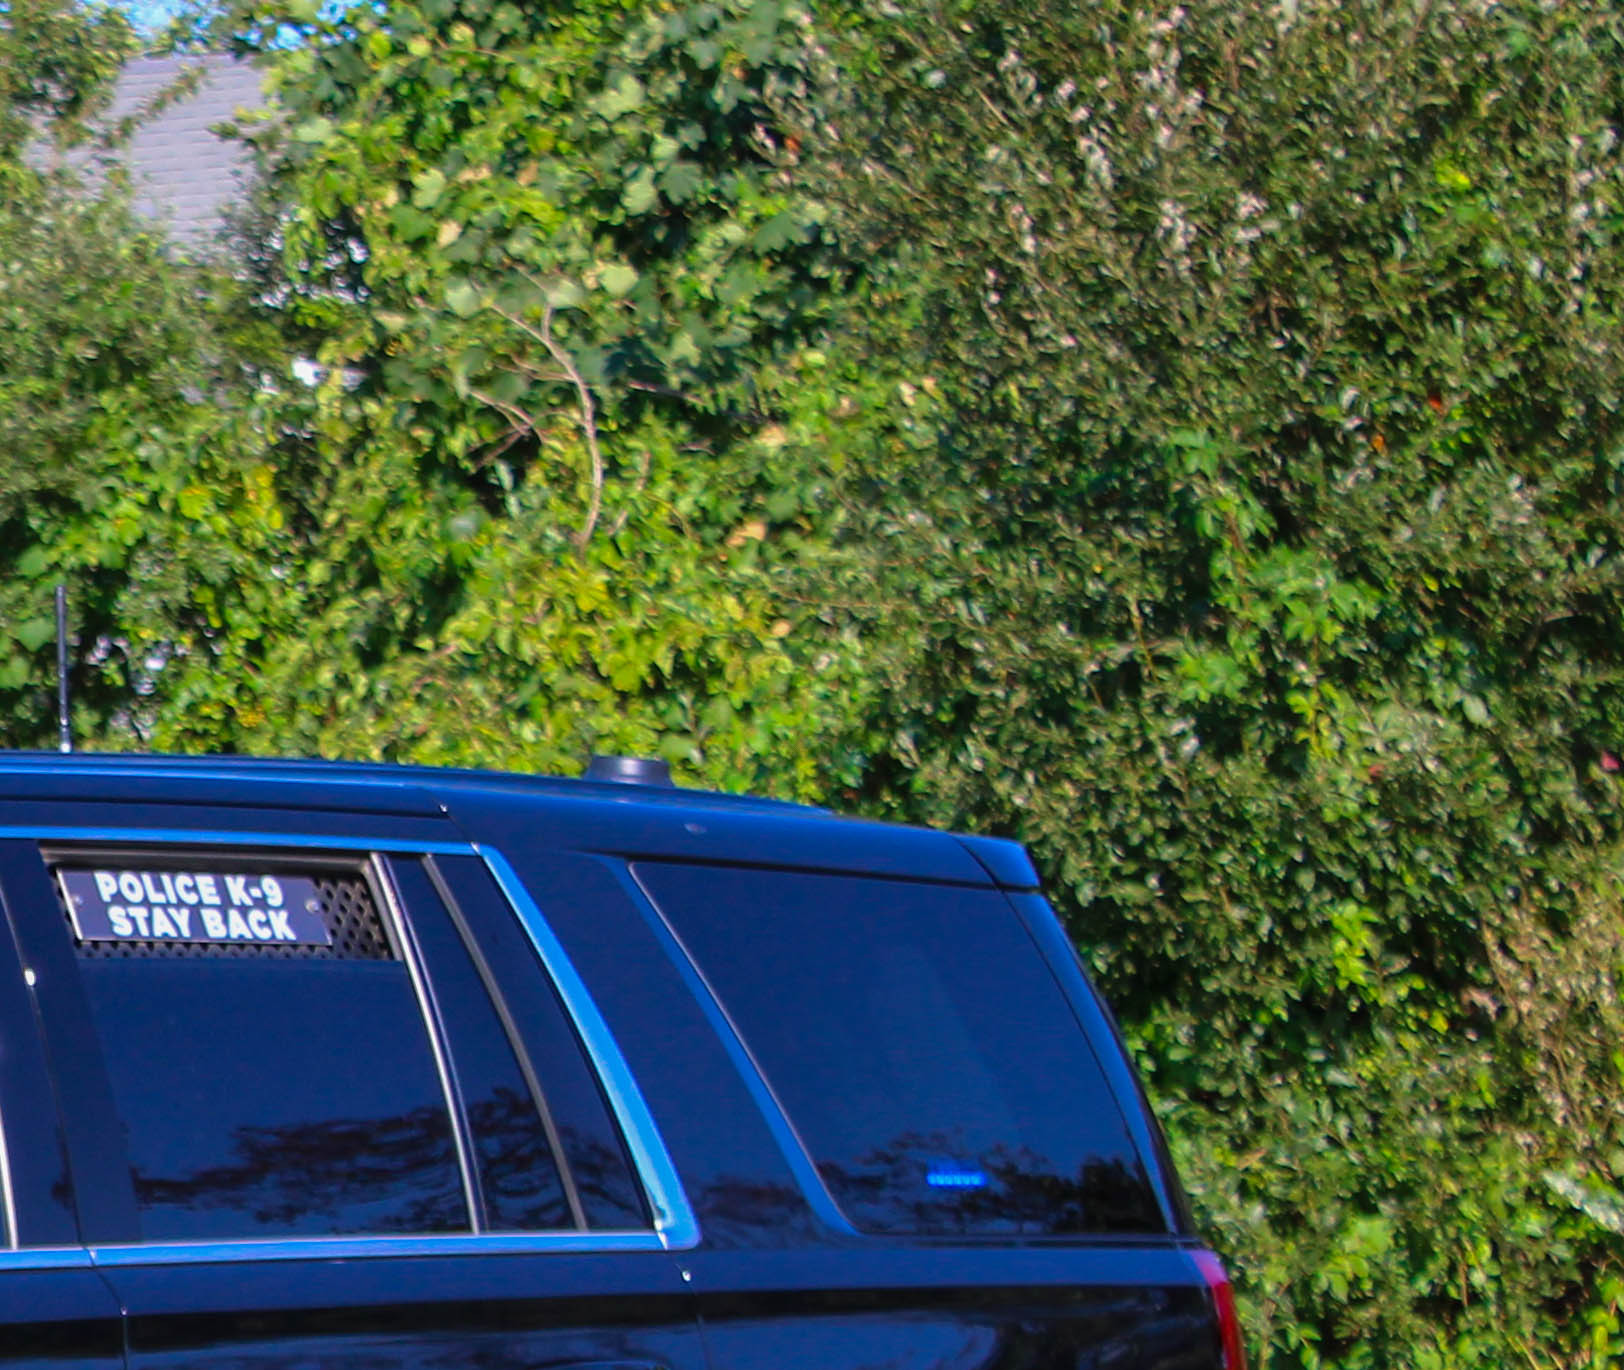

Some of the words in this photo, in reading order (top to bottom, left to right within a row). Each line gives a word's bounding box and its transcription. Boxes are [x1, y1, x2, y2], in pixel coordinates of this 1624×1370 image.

[93, 870, 222, 905] POLICE
[225, 874, 285, 907] K-9
[107, 906, 192, 938] STAY
[199, 909, 297, 941] BACK
